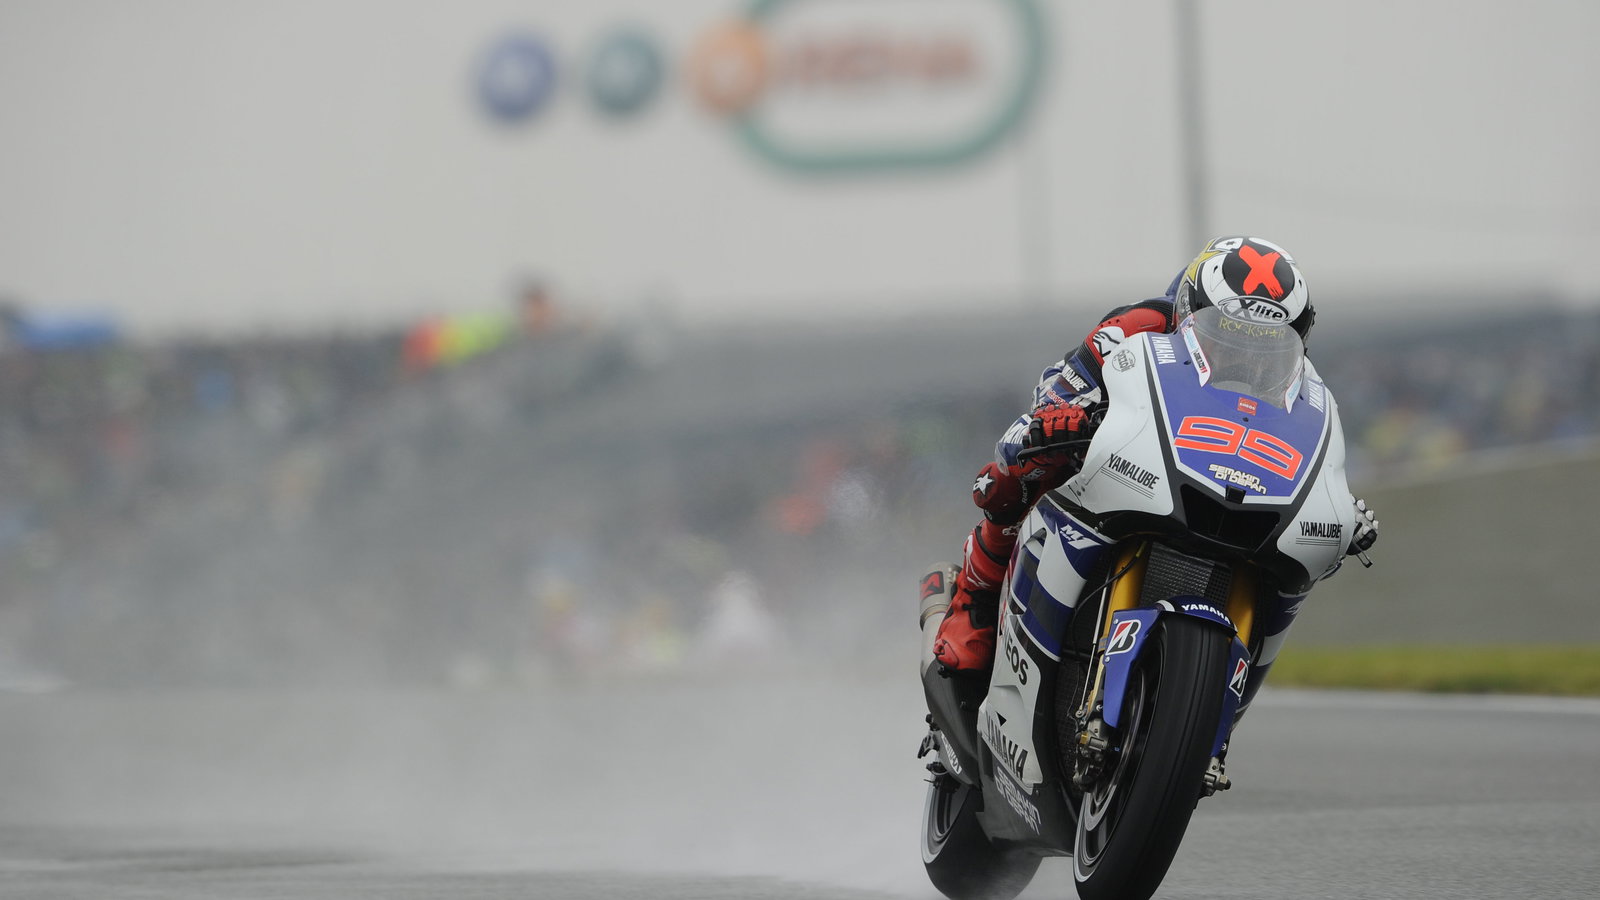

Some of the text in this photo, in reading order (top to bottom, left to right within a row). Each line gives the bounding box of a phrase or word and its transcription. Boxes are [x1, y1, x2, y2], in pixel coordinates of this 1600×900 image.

[1151, 336, 1176, 365] YAMAHA
[1174, 416, 1303, 481] 99
[1109, 454, 1160, 489] YAMALUBE
[1208, 463, 1260, 484] SEMAKIN
[1229, 475, 1267, 494] DEPAN
[1300, 521, 1343, 539] YAMALUBE
[1181, 603, 1231, 625] YAMAHA
[984, 710, 1028, 782] YAMAHA
